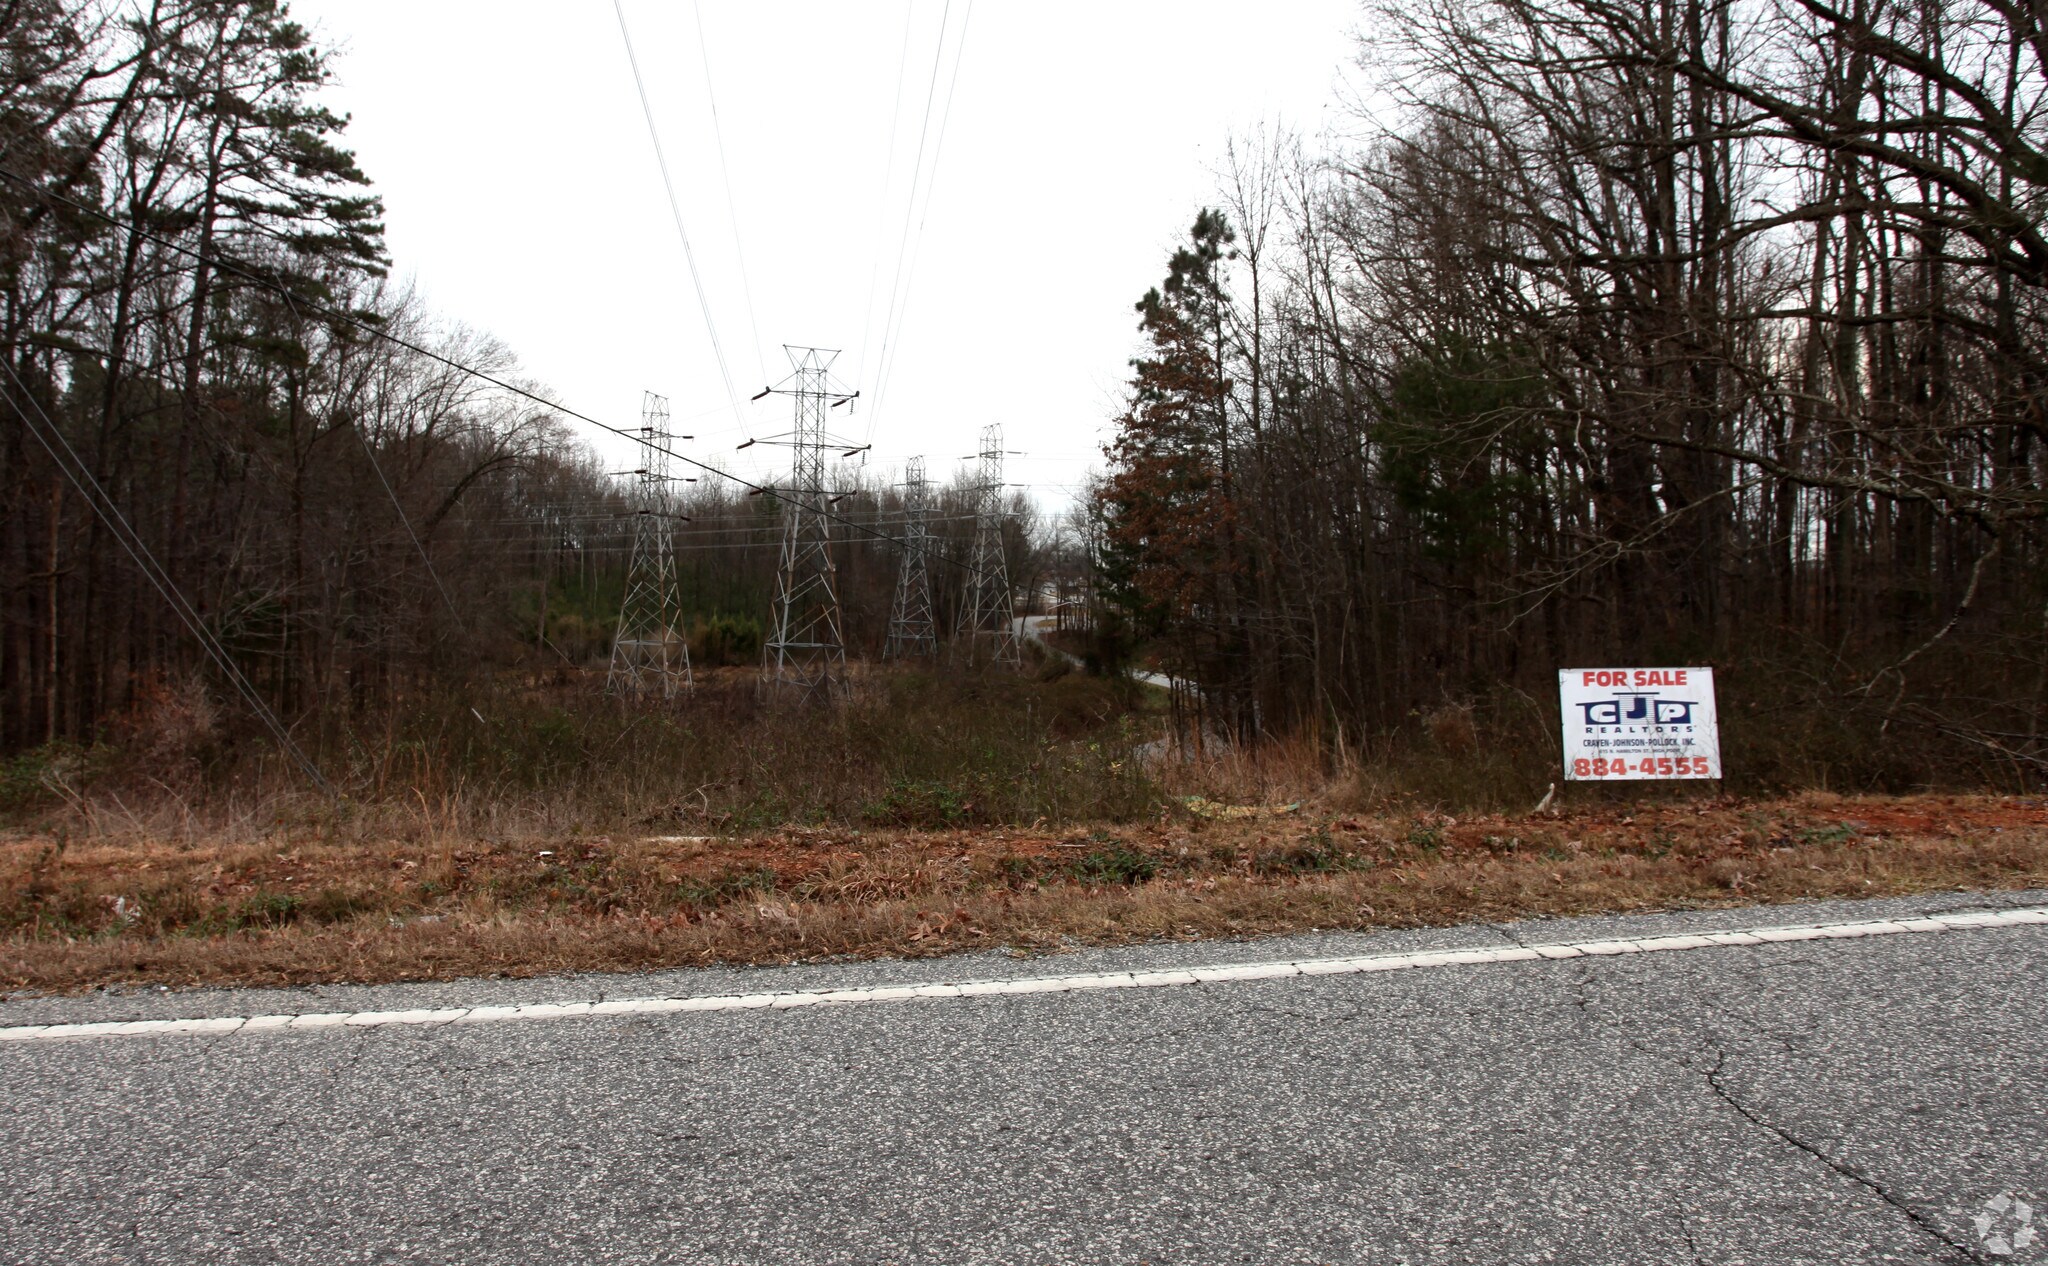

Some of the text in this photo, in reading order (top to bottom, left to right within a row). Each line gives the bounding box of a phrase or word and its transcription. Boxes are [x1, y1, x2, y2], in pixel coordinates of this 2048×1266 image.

[1583, 670, 1687, 687] FOR SALE
[1585, 697, 1691, 725] CJP
[1574, 758, 1710, 777] 884-4555
